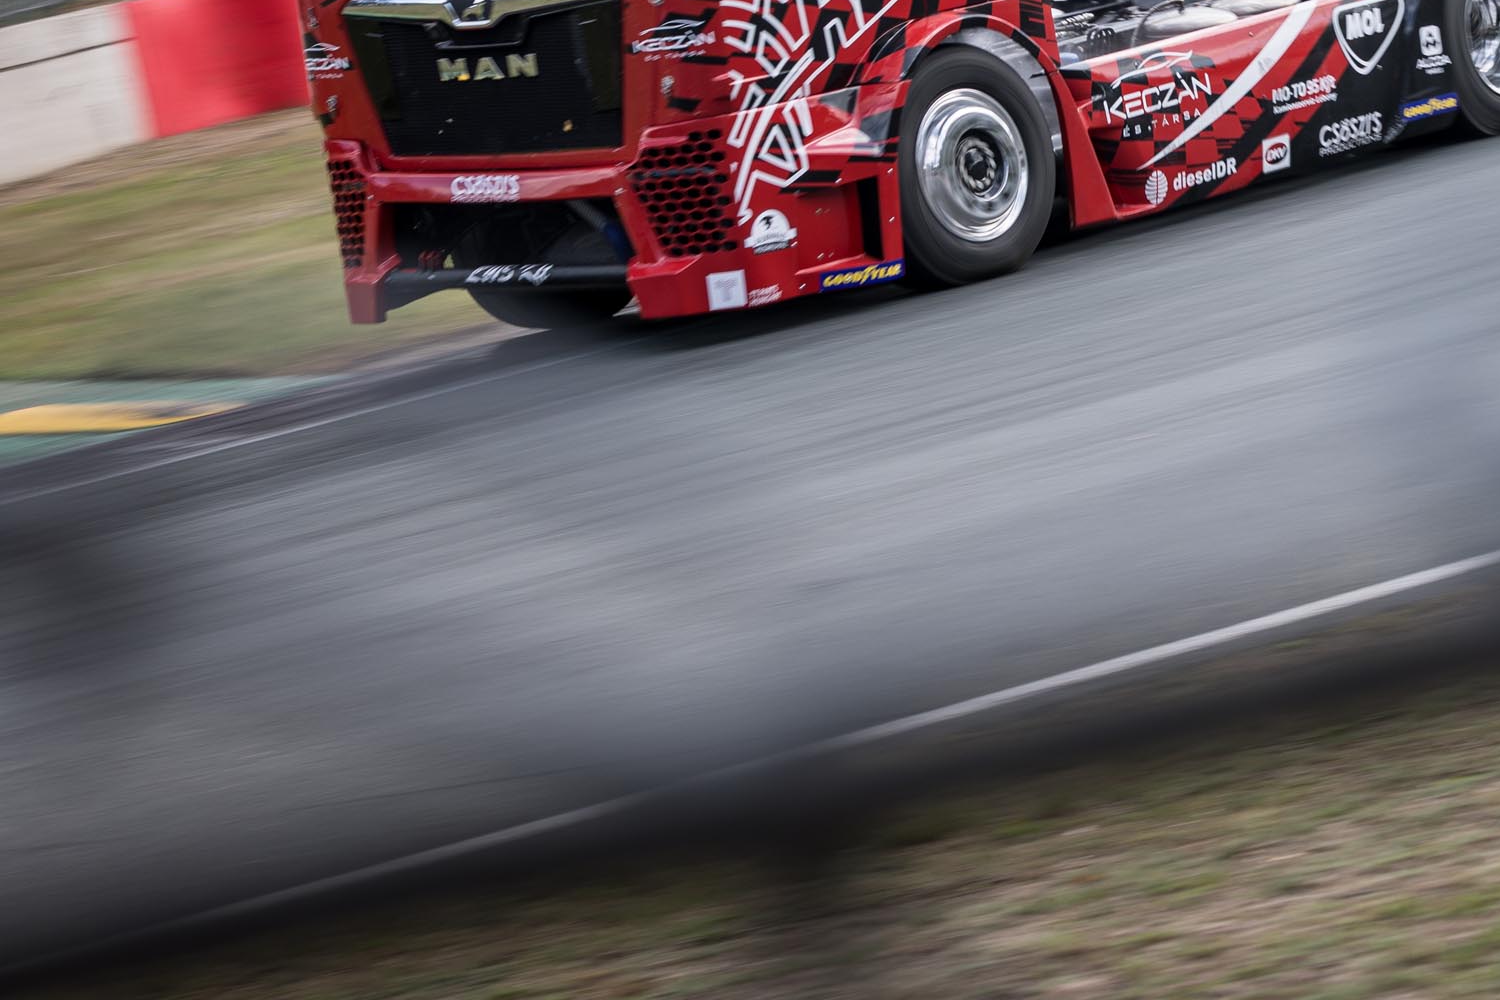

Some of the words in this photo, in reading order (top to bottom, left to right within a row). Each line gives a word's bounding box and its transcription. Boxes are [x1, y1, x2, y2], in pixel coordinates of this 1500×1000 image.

[1345, 7, 1385, 40] MOL
[436, 53, 539, 81] MAN
[1266, 145, 1287, 162] DKV
[1173, 157, 1238, 191] dieselDR
[823, 264, 902, 287] GOODYEAR
